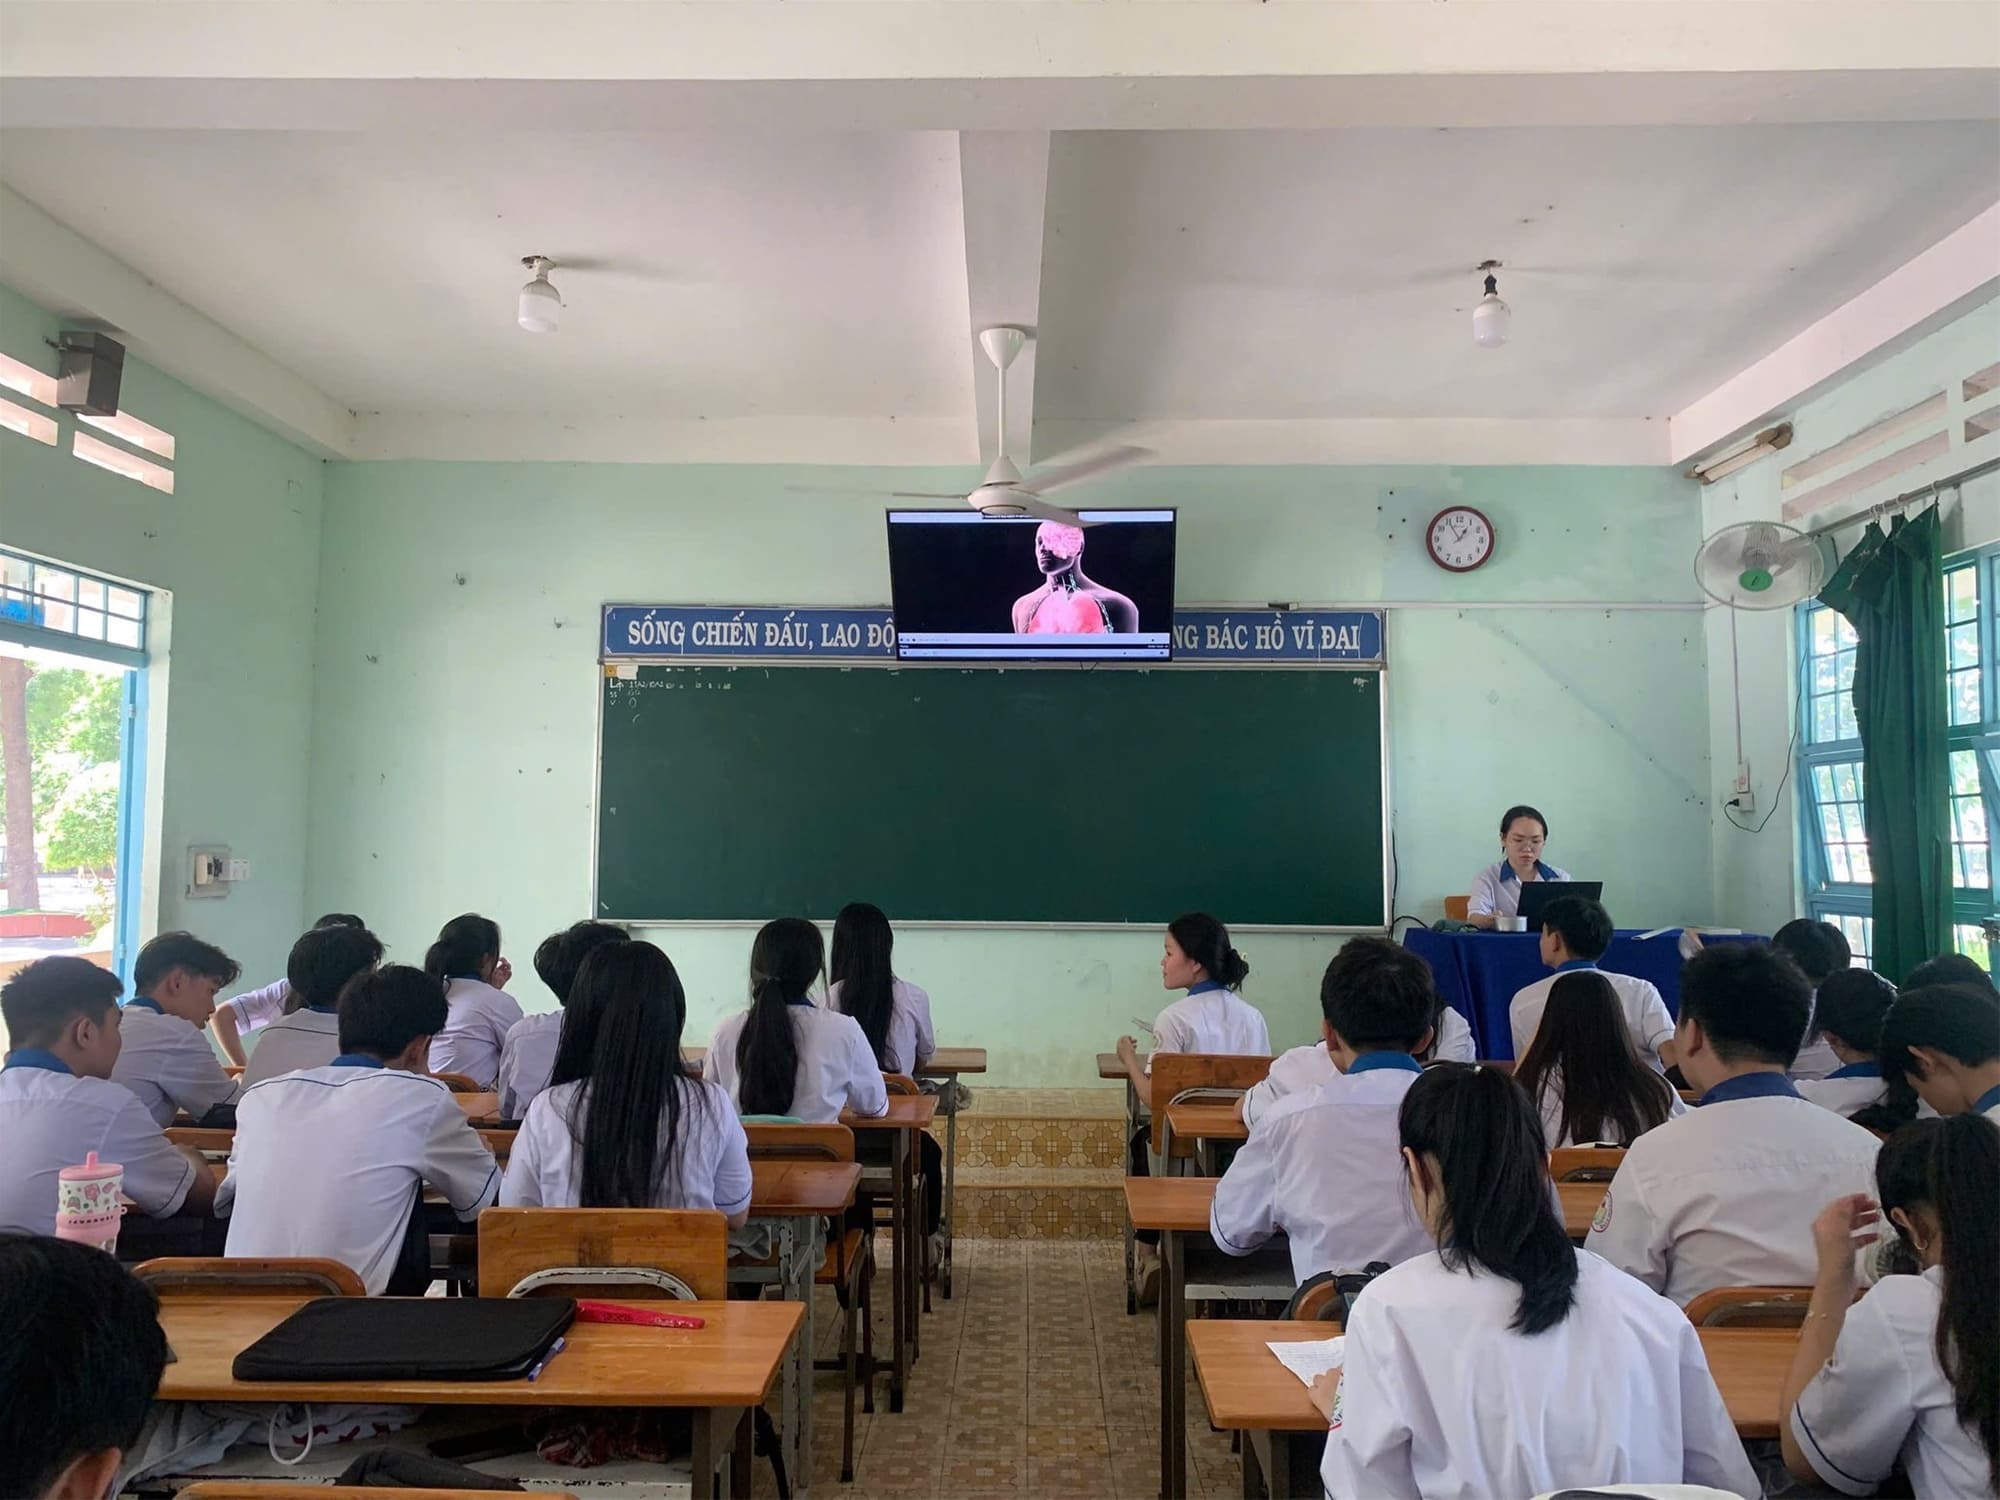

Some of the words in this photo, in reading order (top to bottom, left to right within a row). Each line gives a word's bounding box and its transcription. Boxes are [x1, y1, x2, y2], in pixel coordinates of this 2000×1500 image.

[1456, 515, 1464, 523] 12
[628, 609, 685, 646] SỐNG
[692, 610, 758, 647] CHIẾN
[764, 611, 814, 650] ĐẤU,
[820, 622, 861, 648] LAO
[867, 617, 896, 654] ĐỘ
[1172, 625, 1199, 650] NG
[1206, 618, 1248, 650] BÁC
[1255, 612, 1284, 650] HỒ
[1292, 620, 1315, 650] VĨ
[1321, 625, 1360, 656] ĐẠI
